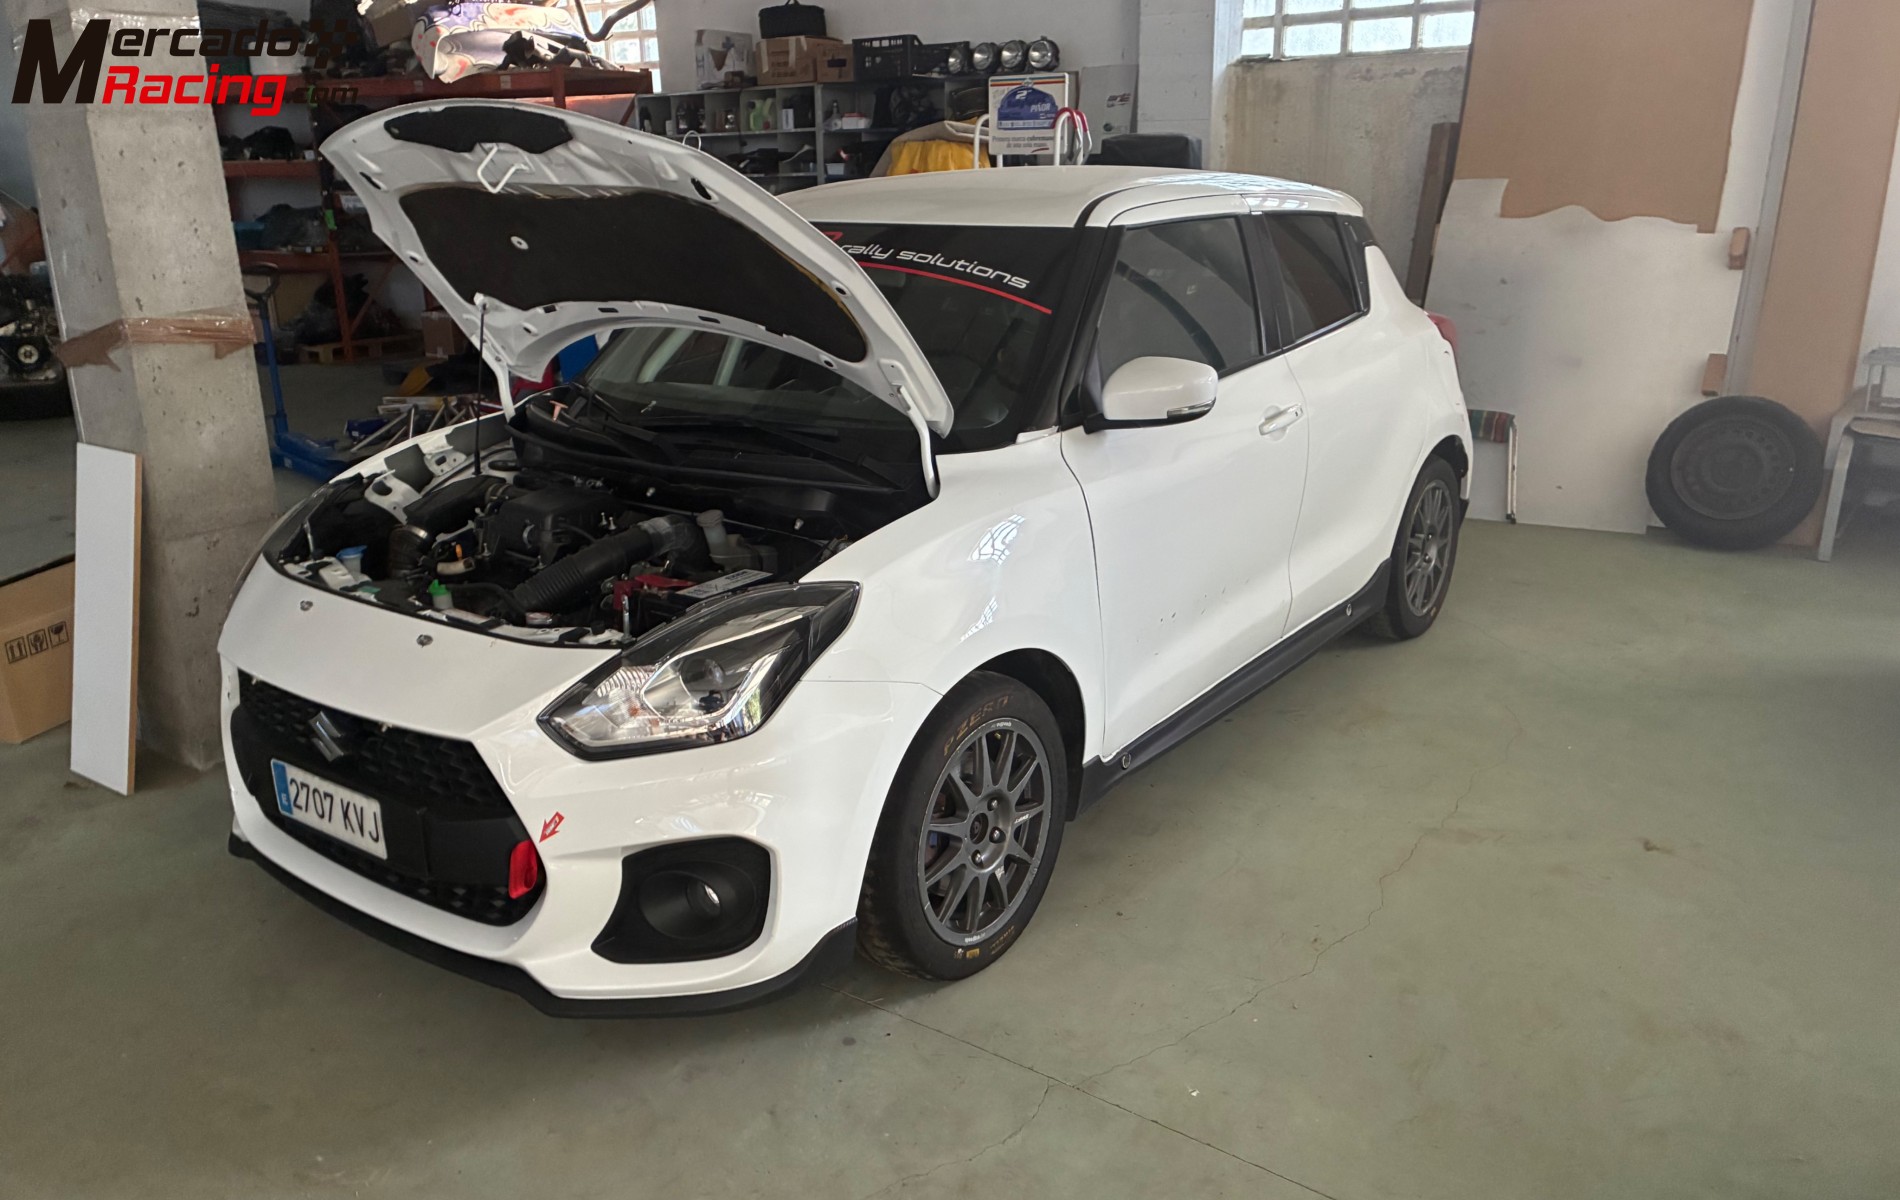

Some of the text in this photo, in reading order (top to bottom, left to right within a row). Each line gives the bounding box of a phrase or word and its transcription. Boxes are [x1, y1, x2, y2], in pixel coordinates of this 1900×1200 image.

[840, 243, 1030, 290] rally solutions
[289, 778, 334, 823] 2707
[340, 797, 380, 844] KVJ
